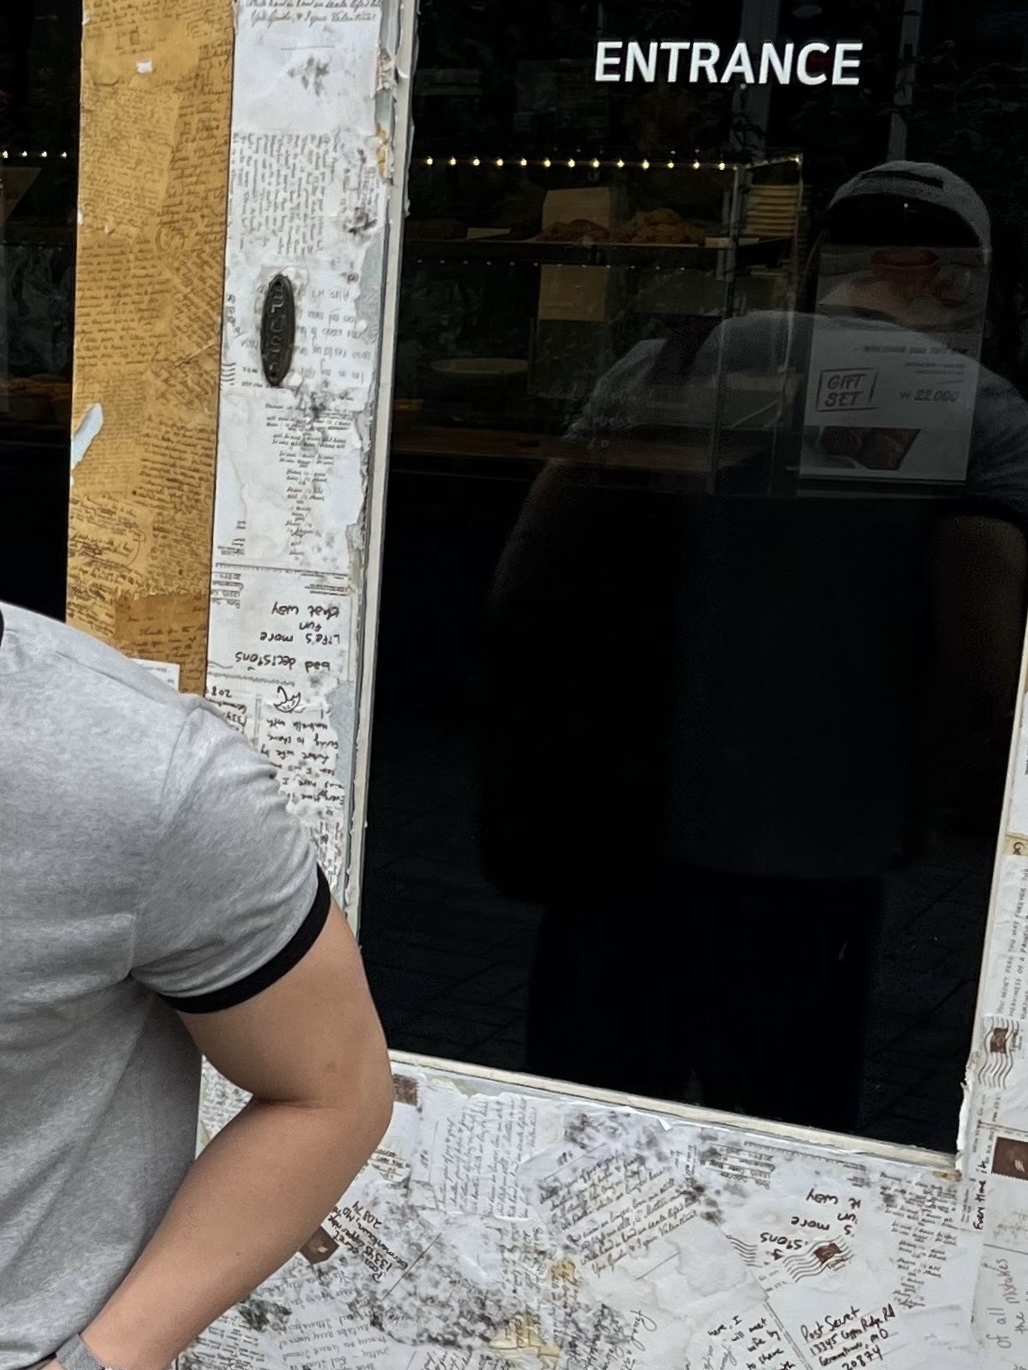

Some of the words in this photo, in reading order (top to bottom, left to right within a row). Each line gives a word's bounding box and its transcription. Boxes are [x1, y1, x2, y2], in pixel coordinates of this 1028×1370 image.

[594, 40, 863, 86] ENTRANCE
[826, 373, 867, 390] GIFT
[824, 391, 863, 408] SET
[271, 601, 299, 615] way
[307, 605, 340, 620] that
[260, 632, 294, 642] more
[304, 660, 330, 673] bad
[806, 1188, 838, 1205] way
[791, 1216, 830, 1230] more
[800, 1321, 823, 1343] Post
[809, 1333, 838, 1356] 13345
[841, 1344, 883, 1370] 20874
